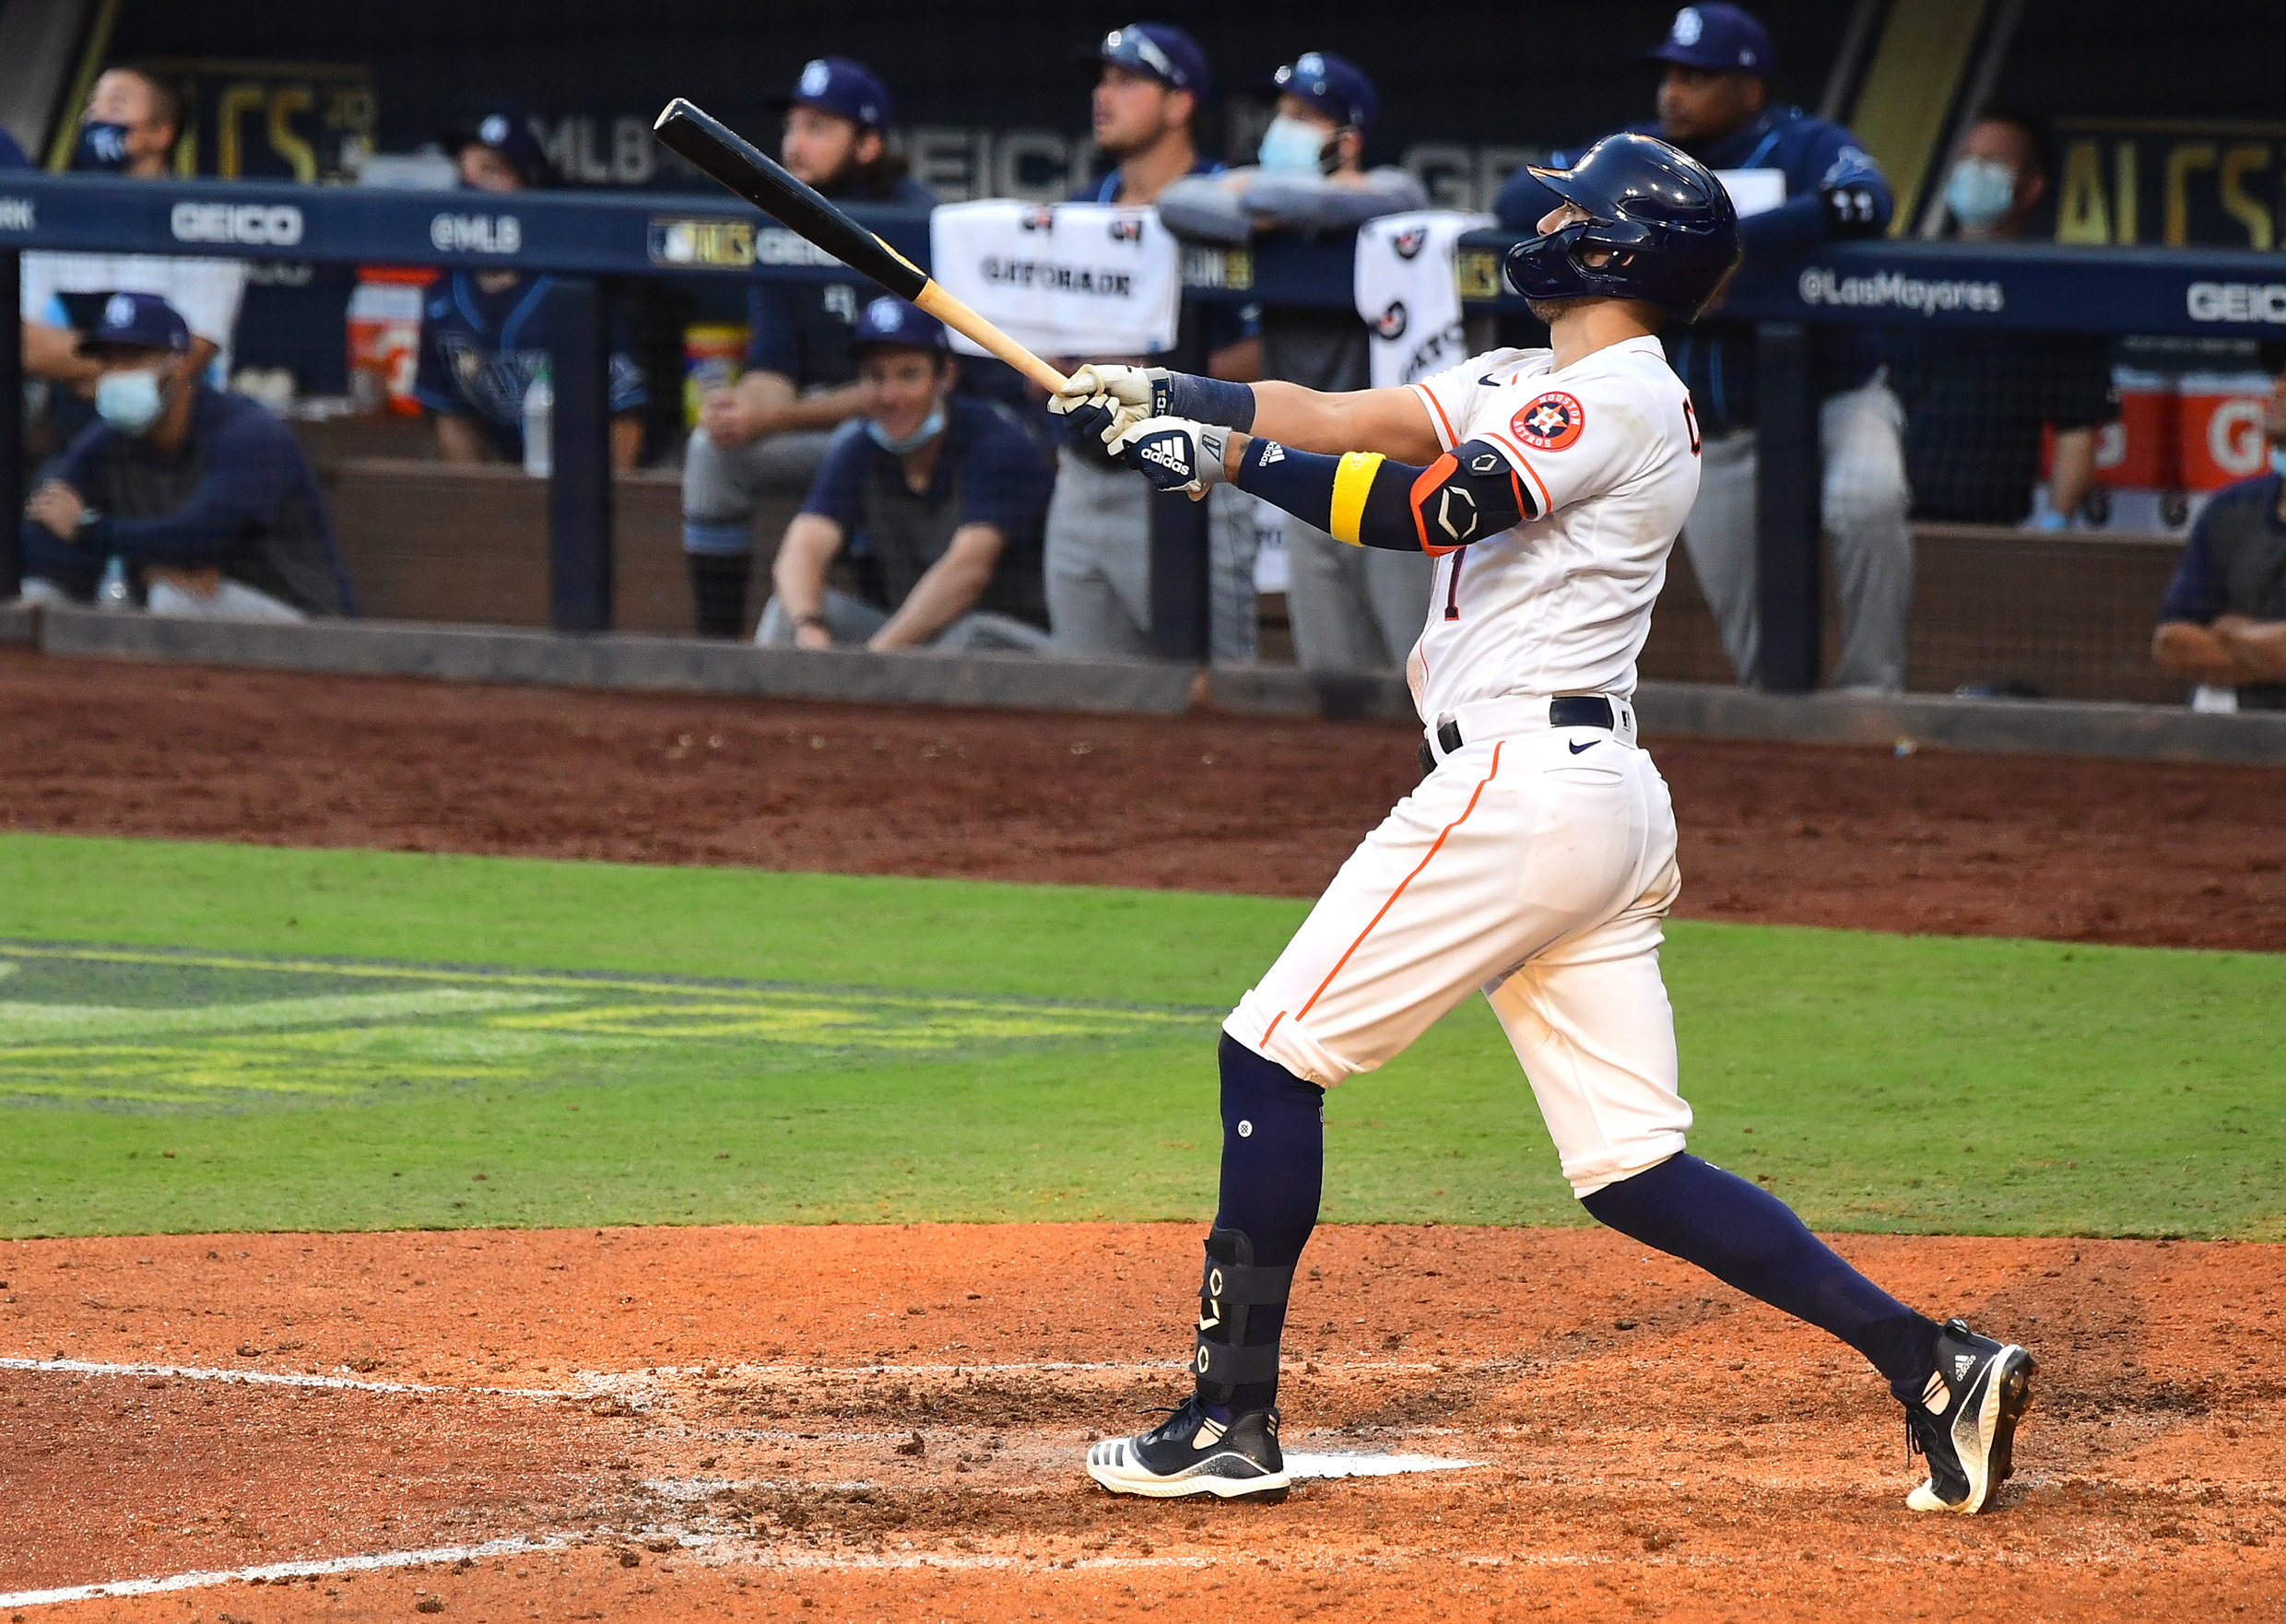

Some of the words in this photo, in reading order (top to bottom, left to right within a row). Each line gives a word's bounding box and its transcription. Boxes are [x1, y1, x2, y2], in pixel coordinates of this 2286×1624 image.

[171, 203, 302, 245] GEICO
[430, 213, 521, 253] @MLB
[1799, 267, 2005, 317] @LasMayores
[1538, 394, 1580, 425] HOUSTON
[1513, 420, 1551, 448] ASTROS
[2209, 402, 2265, 476] G
[1140, 448, 1190, 476] adidas
[1956, 1354, 1977, 1382] adidas
